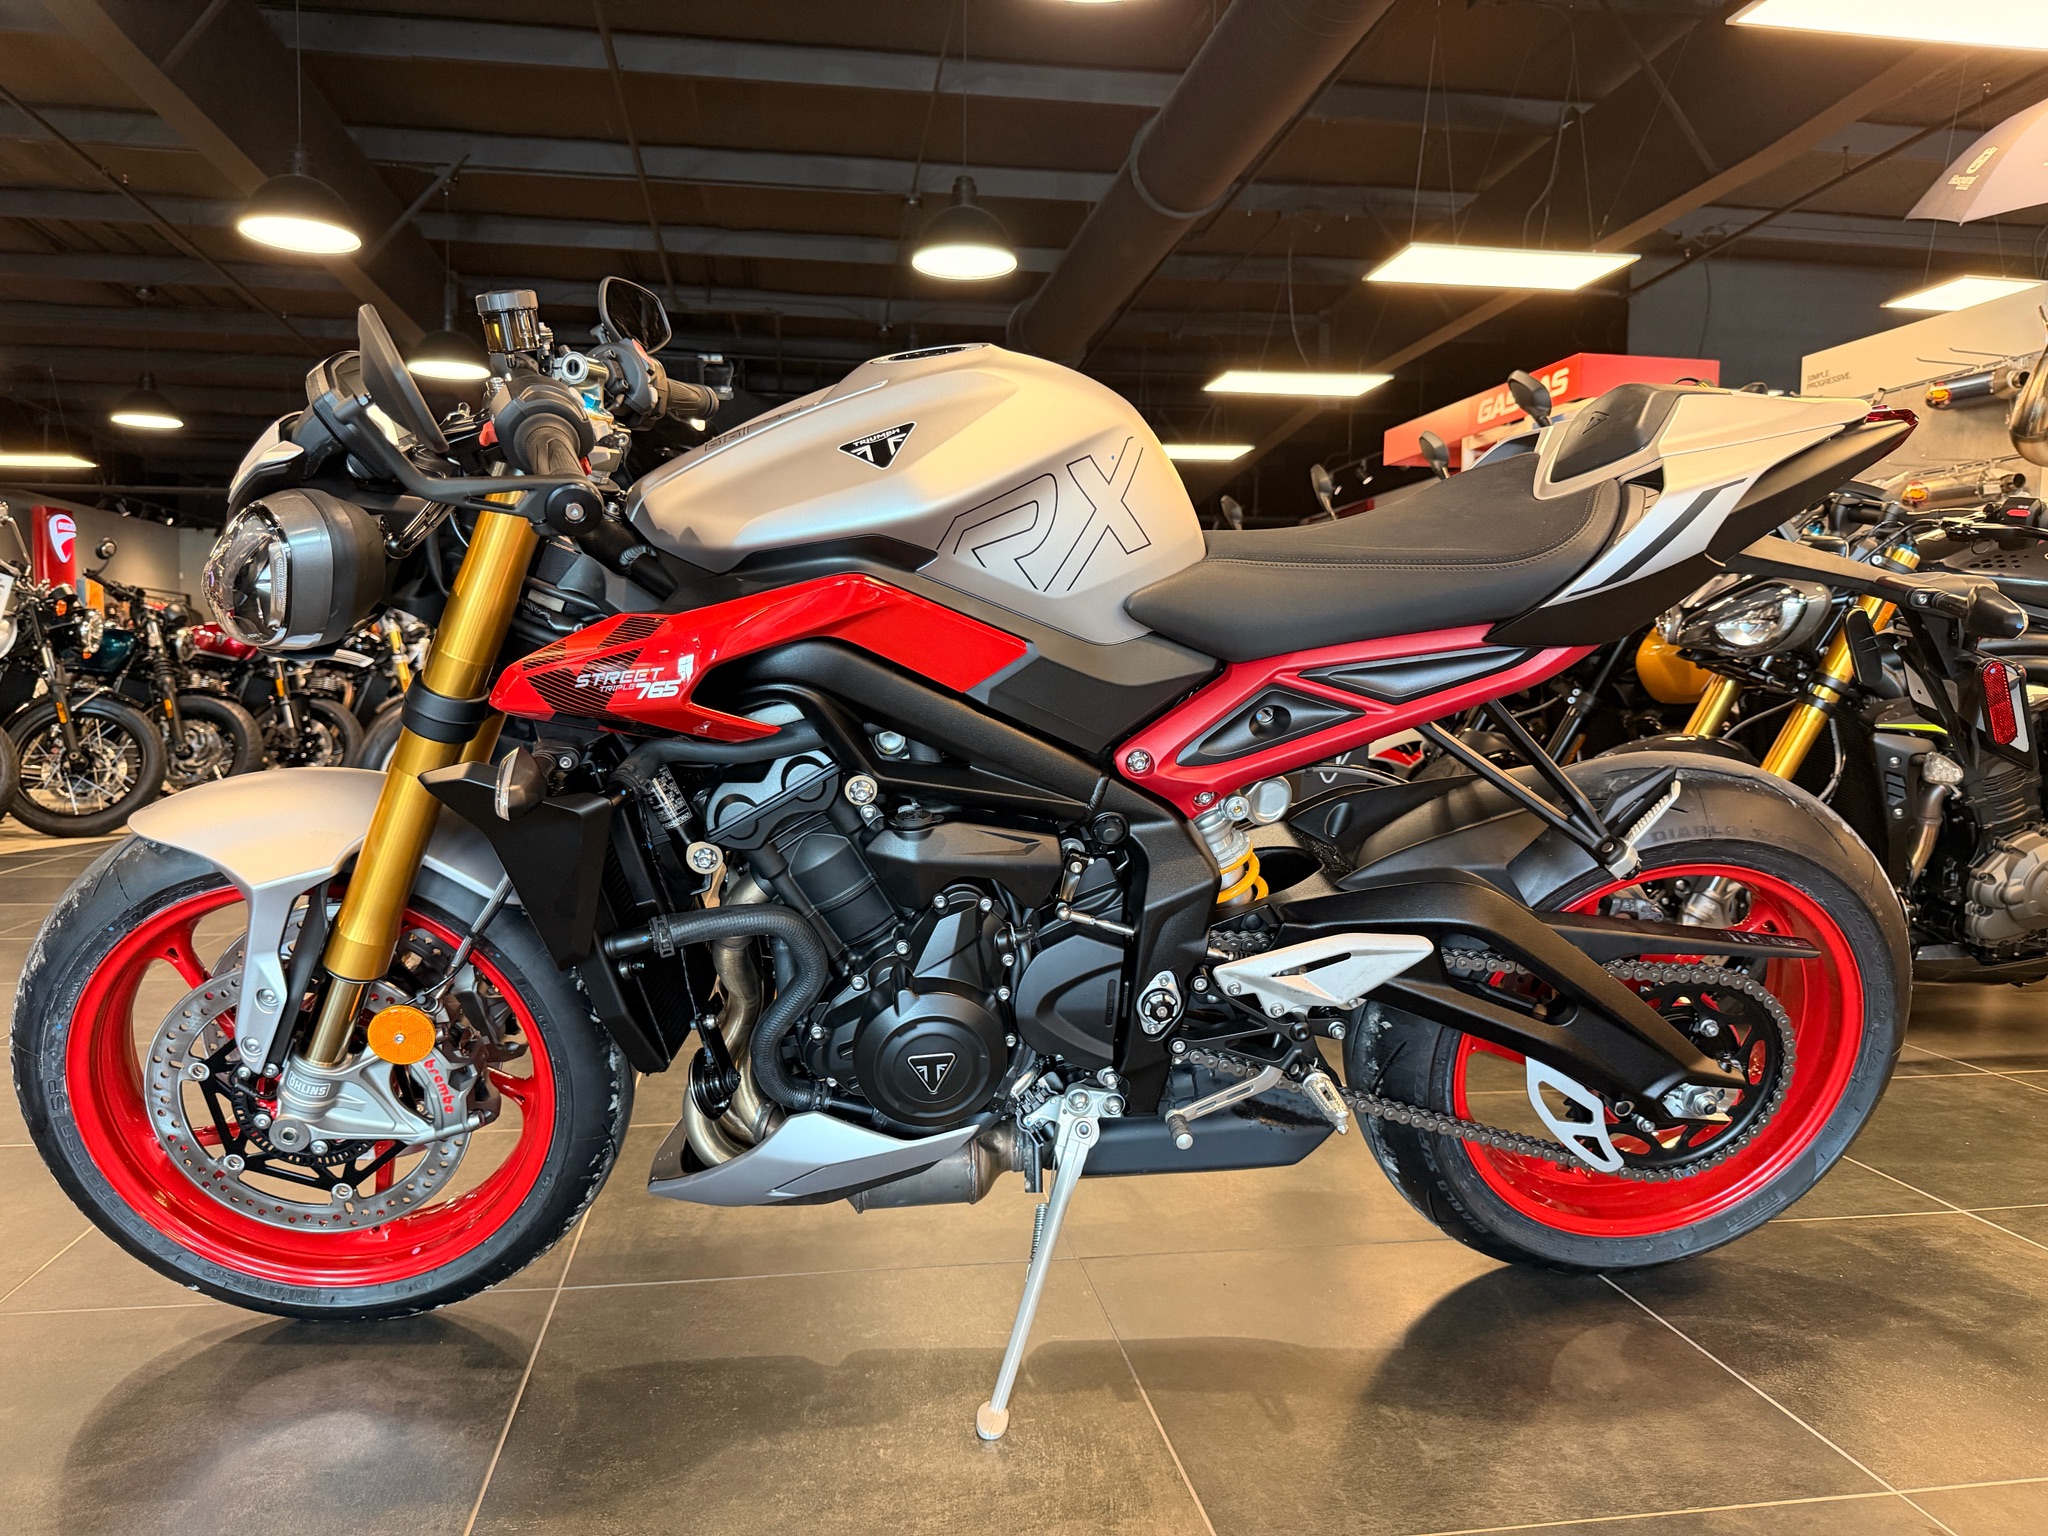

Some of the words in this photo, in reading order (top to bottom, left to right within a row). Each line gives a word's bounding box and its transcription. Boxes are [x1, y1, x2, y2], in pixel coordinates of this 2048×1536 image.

[1477, 367, 1570, 424] GASS
[853, 428, 900, 447] TRIUMPH
[936, 436, 1152, 593] RX
[574, 667, 665, 689] STREET
[599, 684, 636, 693] TRIPLE
[635, 679, 682, 700] 765
[1651, 825, 1740, 843] DIABLO
[47, 1079, 66, 1111] SP
[423, 1057, 456, 1114] brembo
[58, 1123, 157, 1242] SUPERCORSA
[1436, 1178, 1490, 1235] DIABLO
